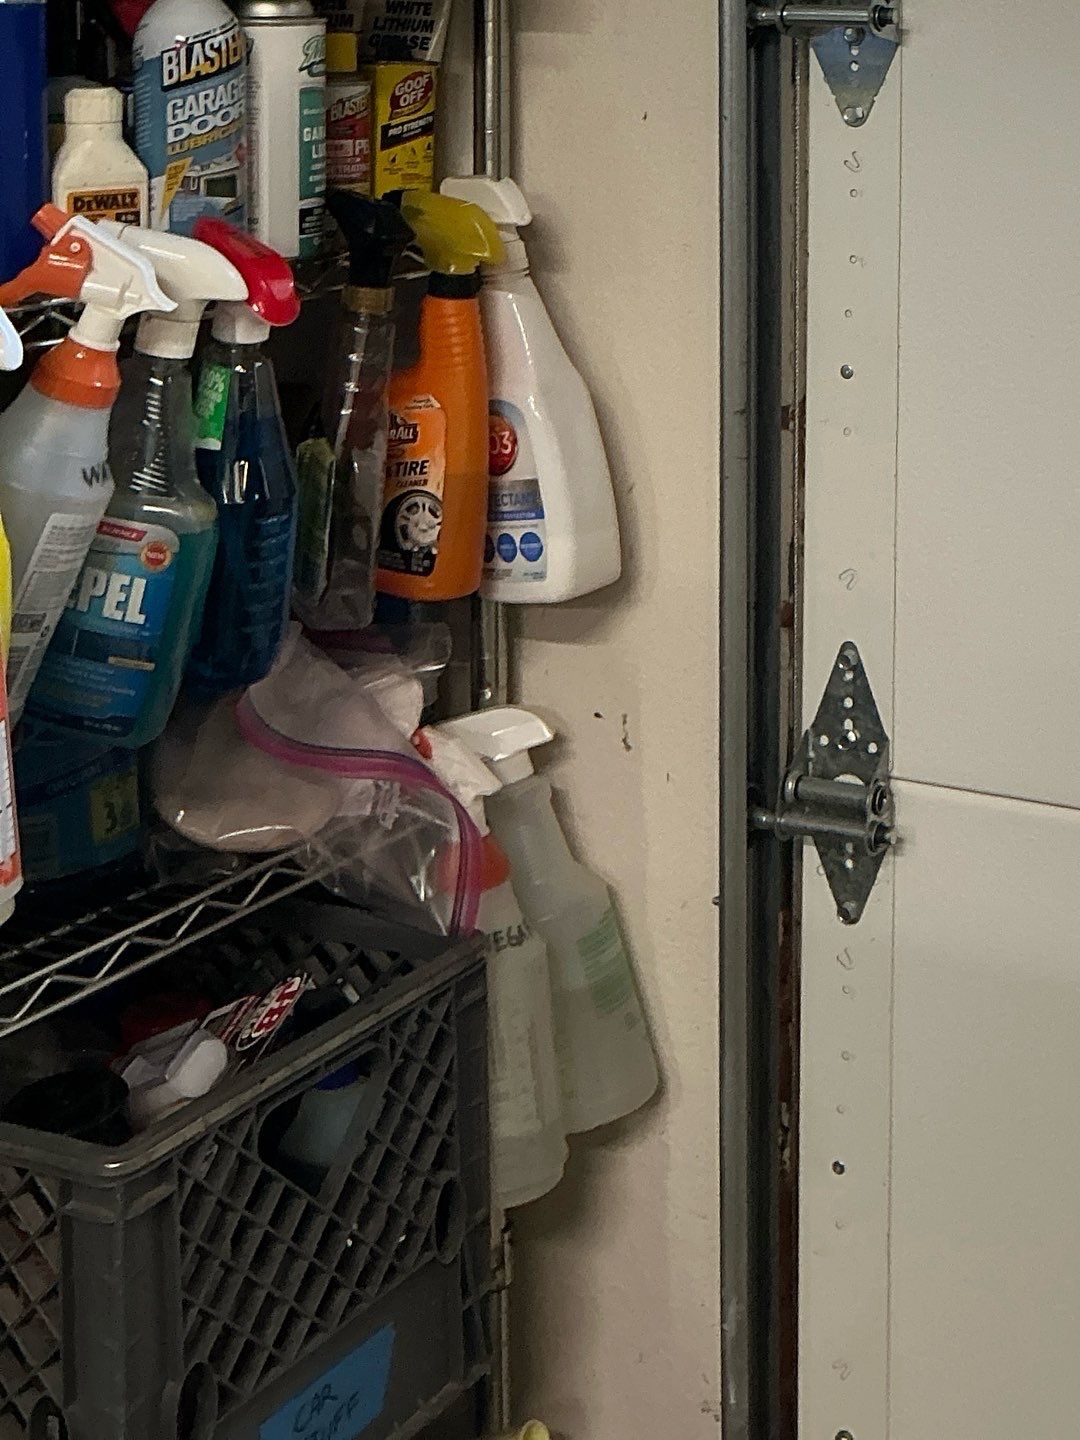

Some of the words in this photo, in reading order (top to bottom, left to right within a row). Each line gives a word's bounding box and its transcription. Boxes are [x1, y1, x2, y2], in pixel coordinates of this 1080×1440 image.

[386, 0, 432, 16] WHITE
[373, 17, 434, 33] LITHIUM
[395, 73, 431, 97] GOOF
[399, 87, 425, 107] OFF
[395, 459, 430, 478] TIRE
